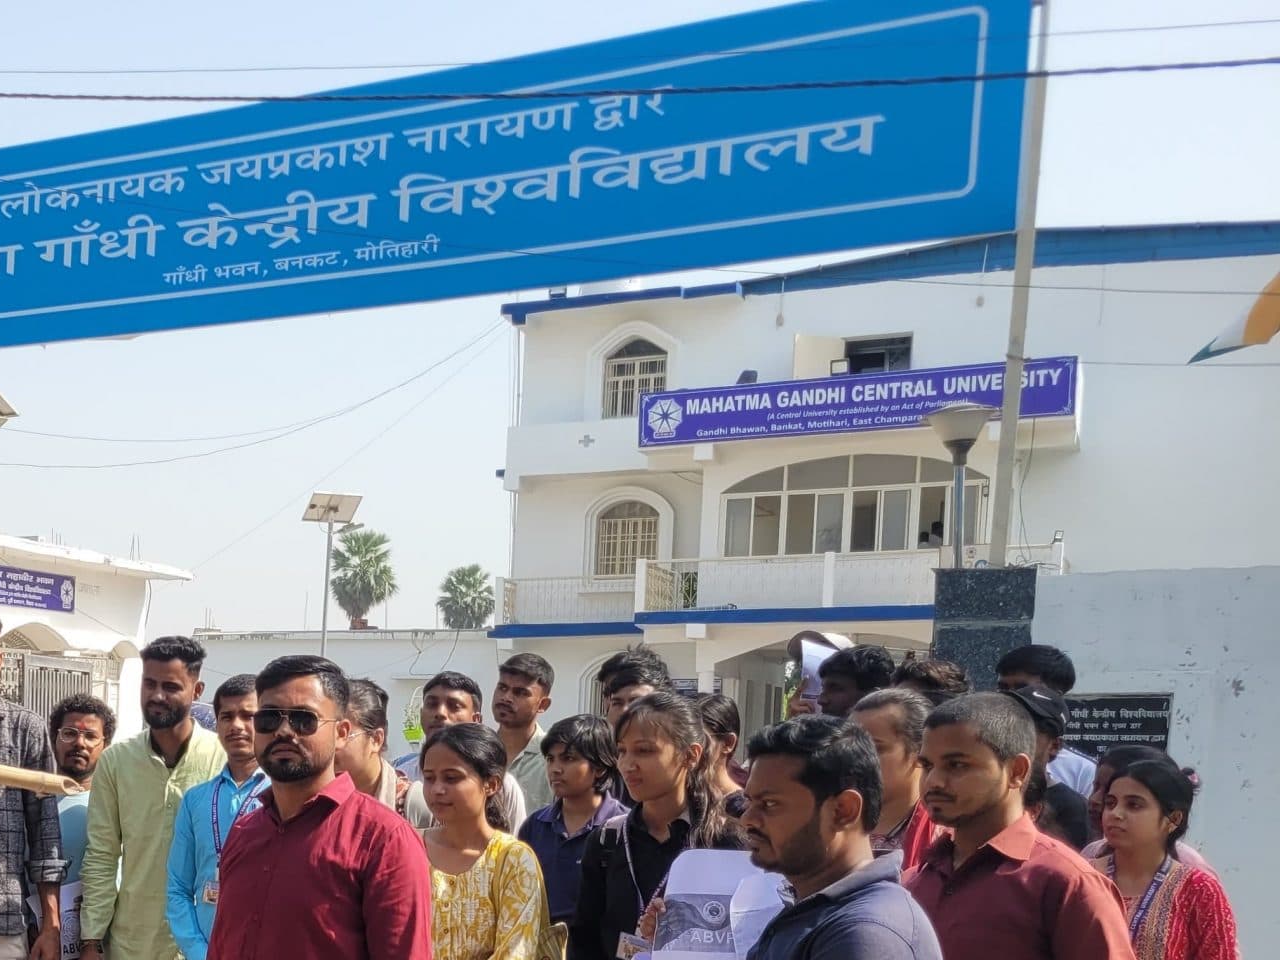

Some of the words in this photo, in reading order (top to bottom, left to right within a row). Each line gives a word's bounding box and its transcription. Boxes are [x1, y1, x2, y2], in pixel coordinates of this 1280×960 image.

[197, 132, 394, 186] जयप्रकाश
[402, 102, 579, 154] नारायण
[589, 84, 673, 132] द्वार
[33, 214, 167, 268] गाँधी
[176, 189, 379, 249] केन्द्रीय
[390, 113, 886, 223] विश्वविद्यालय
[163, 264, 207, 287] गाँधी
[355, 234, 441, 262] मोतिहारी
[686, 391, 772, 415] MAHATMA
[776, 384, 846, 408] GANDHI
[851, 379, 937, 402] CENTRAL
[943, 367, 1063, 394] UNIVESITY
[776, 410, 801, 420] Central
[803, 407, 838, 419] University
[839, 404, 880, 416] established
[881, 404, 890, 414] by
[901, 401, 915, 411] Act
[916, 400, 924, 410] of
[696, 427, 728, 437] Gandhi
[730, 424, 768, 435] Bhawan,
[771, 421, 804, 432] Bankat,
[807, 418, 850, 430] Motihari,
[852, 416, 872, 426] East
[874, 414, 924, 426] Champara
